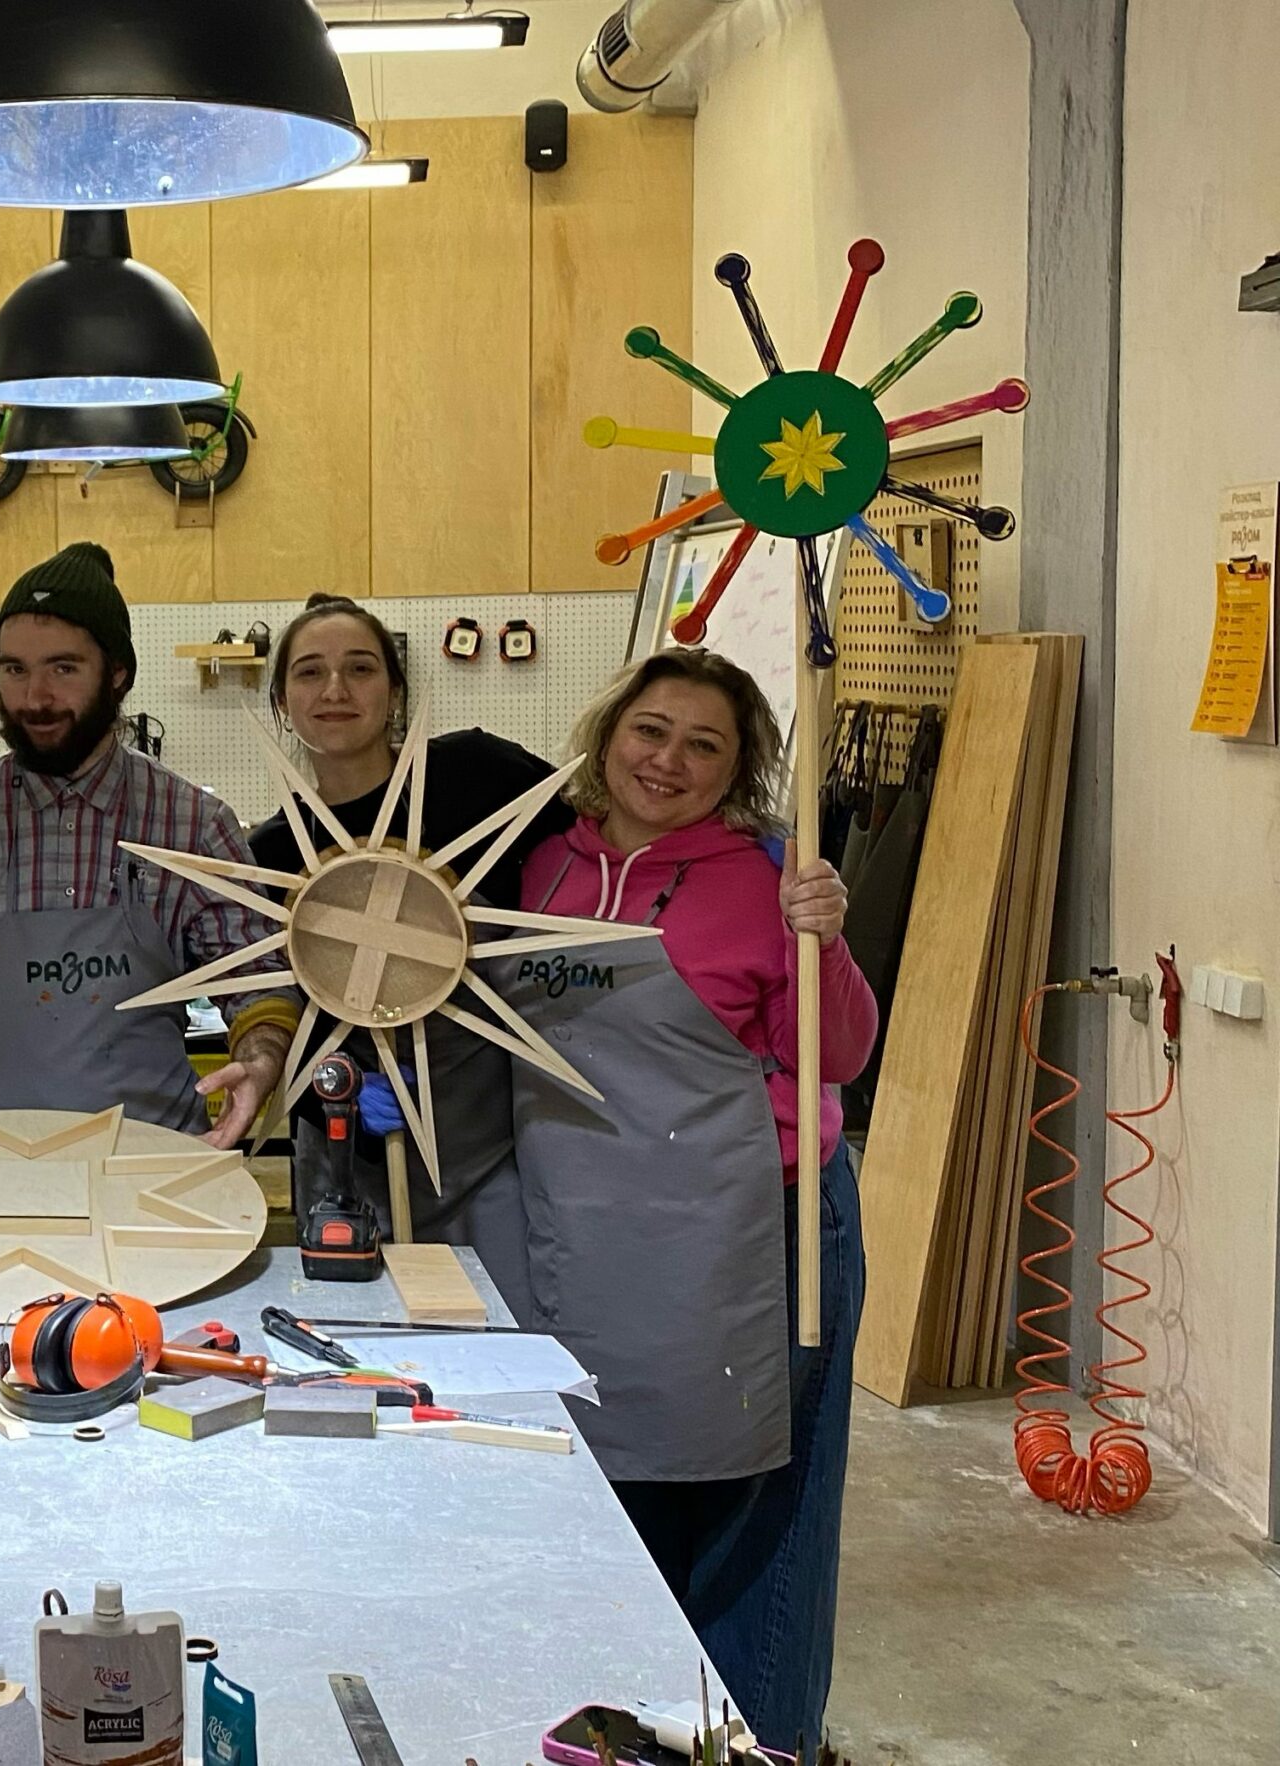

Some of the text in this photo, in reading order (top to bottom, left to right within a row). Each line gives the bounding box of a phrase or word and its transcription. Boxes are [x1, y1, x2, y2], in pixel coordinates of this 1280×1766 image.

[26, 951, 131, 994] РАЗОМ
[517, 954, 615, 999] РАЗОМ
[88, 1718, 141, 1730] ACRYLIC
